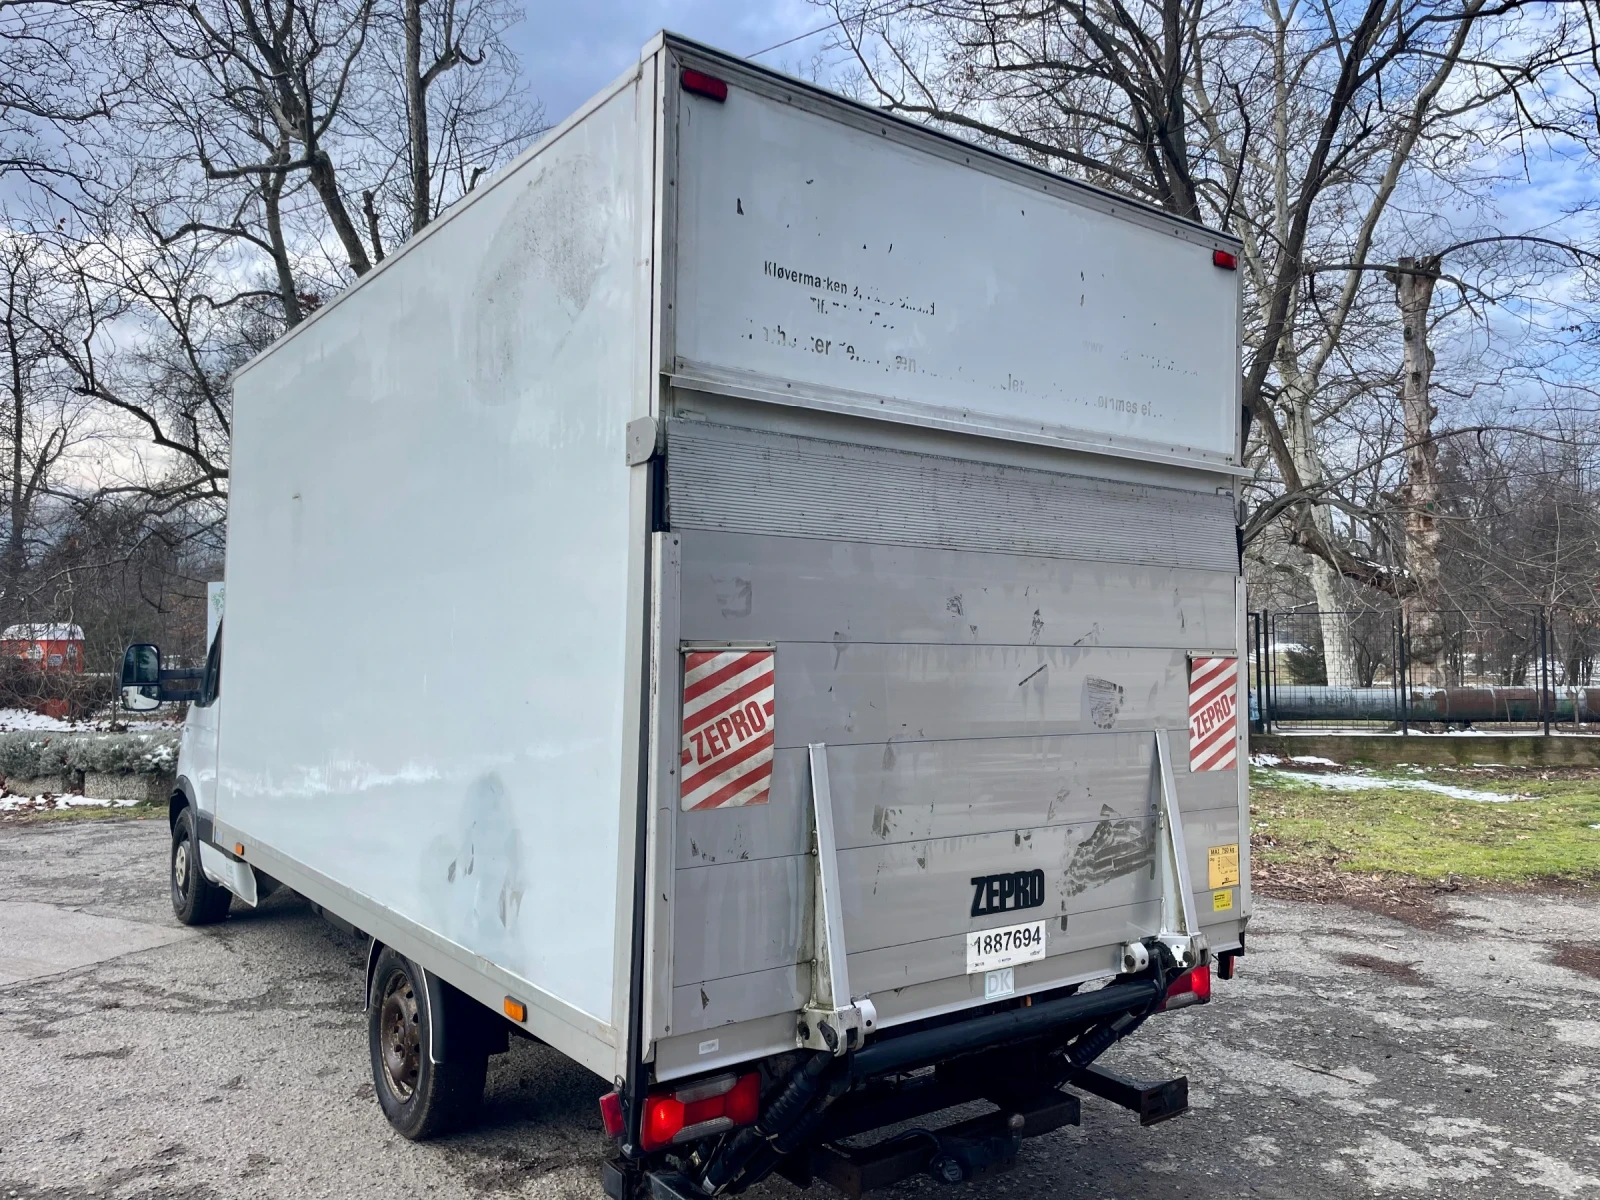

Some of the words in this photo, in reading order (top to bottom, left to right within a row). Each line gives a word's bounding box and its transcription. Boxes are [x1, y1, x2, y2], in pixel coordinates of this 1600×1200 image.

[689, 701, 766, 765] ZEPRO
[1193, 694, 1231, 740] ZEPRO
[970, 868, 1045, 917] ZEPRO
[972, 926, 1042, 956] 1887694
[987, 970, 1011, 995] DK
